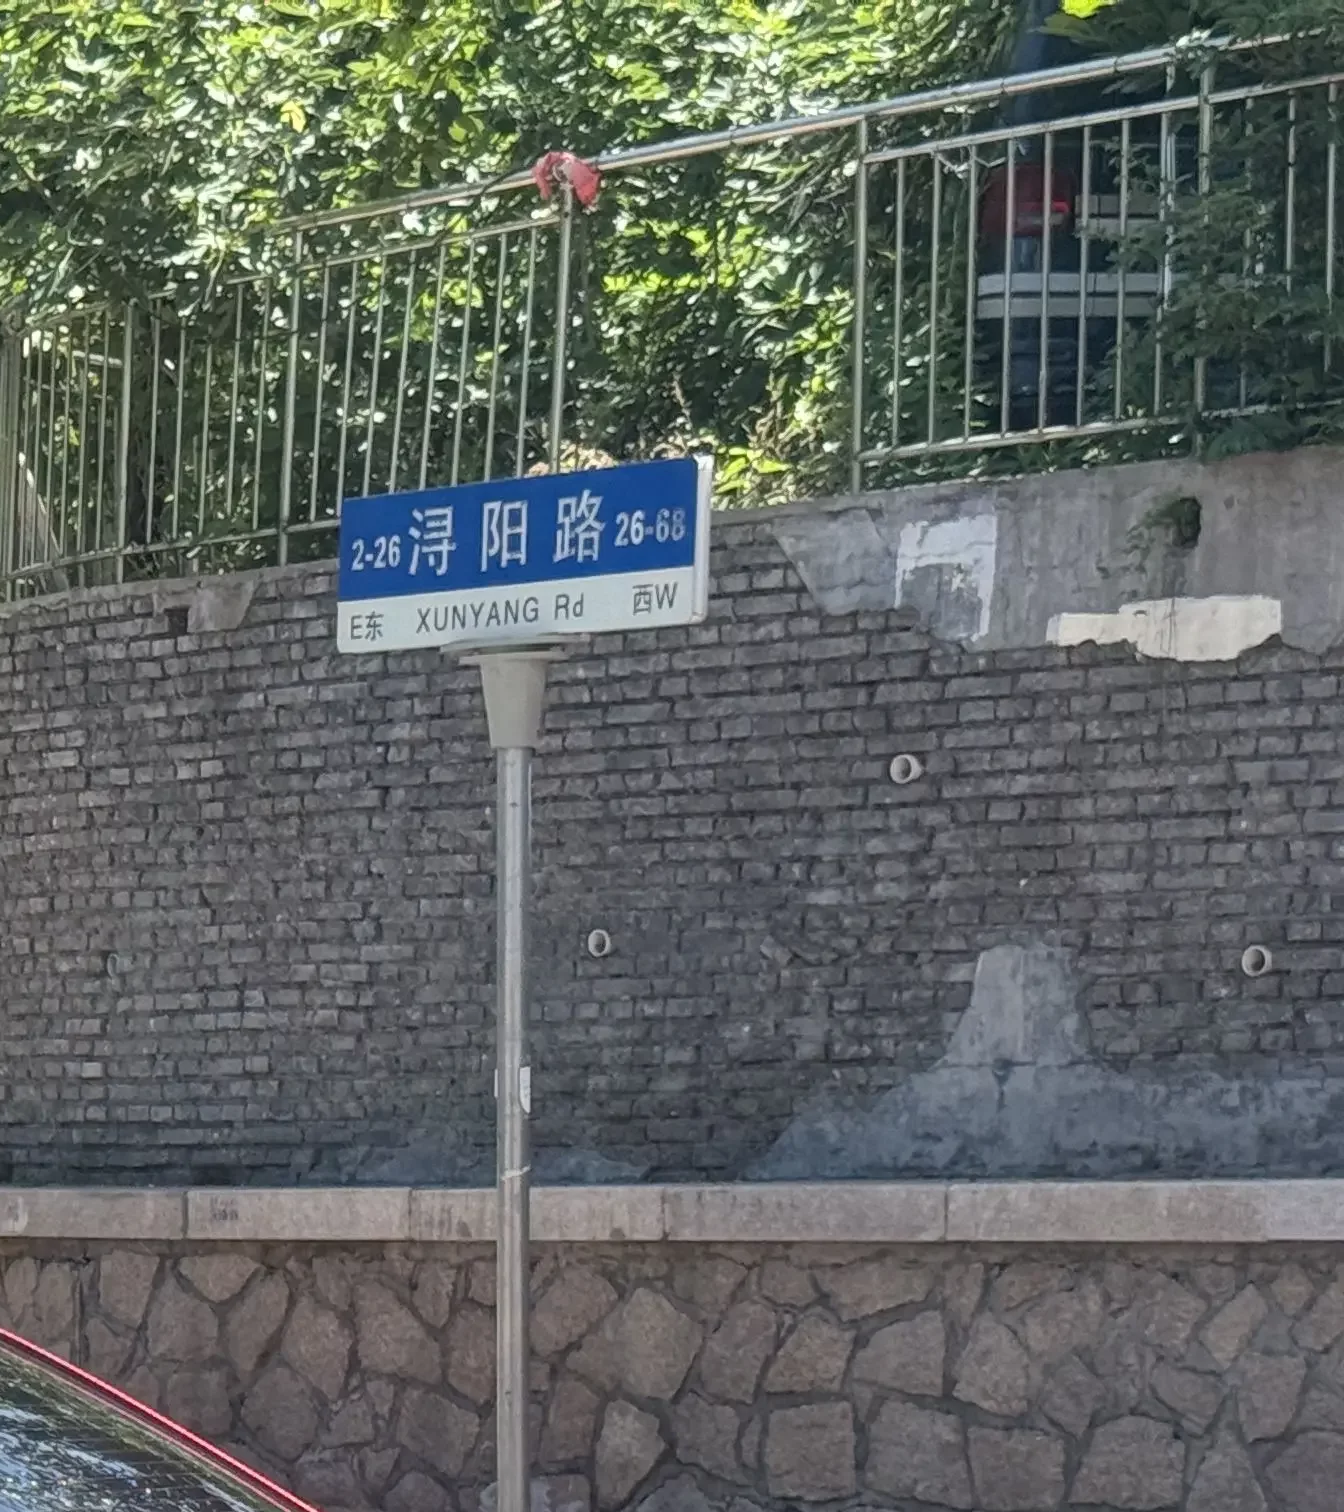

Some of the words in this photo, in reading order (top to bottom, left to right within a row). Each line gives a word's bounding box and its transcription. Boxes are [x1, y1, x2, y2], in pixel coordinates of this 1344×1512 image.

[350, 534, 402, 572] 2-26
[407, 489, 606, 576] 浔阳路
[613, 507, 687, 547] 26-68
[415, 595, 540, 634] XUNYANG
[553, 593, 585, 620] Rd
